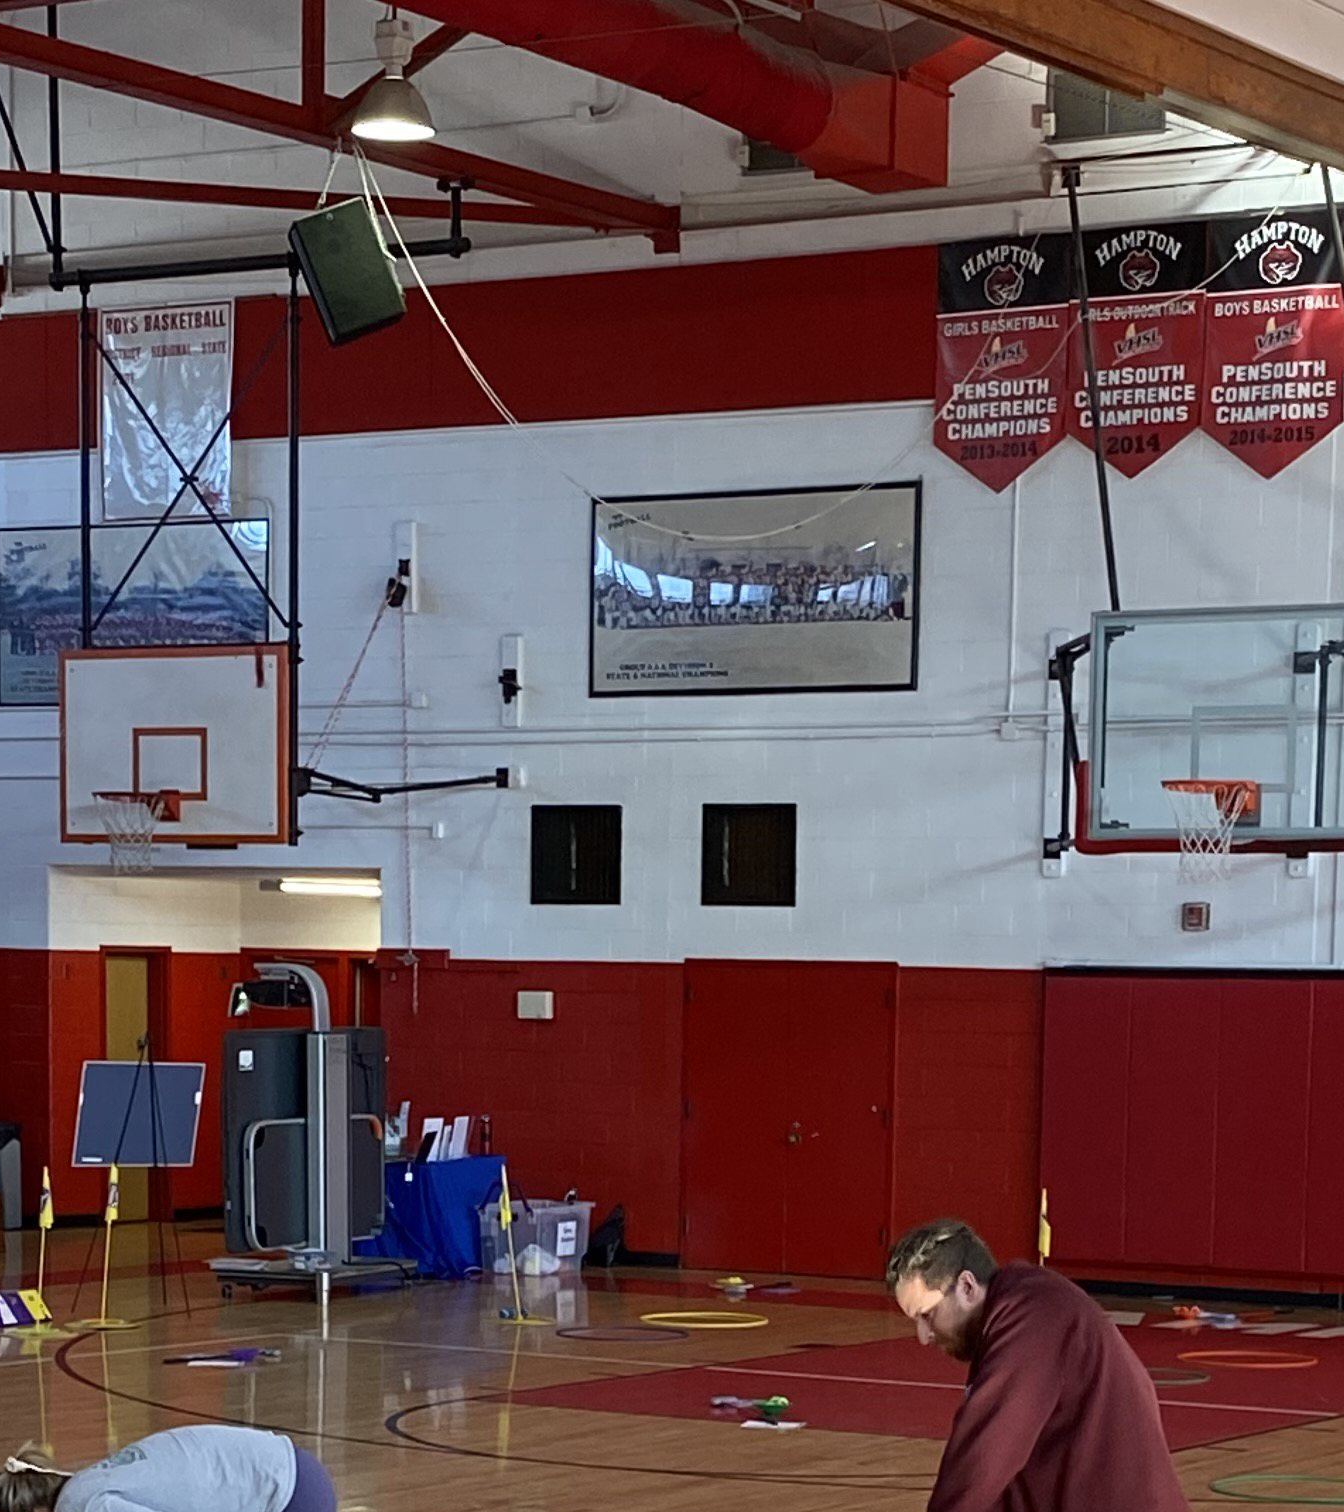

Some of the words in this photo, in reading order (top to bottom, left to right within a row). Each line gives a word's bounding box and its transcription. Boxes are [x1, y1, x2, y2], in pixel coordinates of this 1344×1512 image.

[1095, 229, 1182, 267] HAMPTON
[1234, 221, 1325, 260] HAMPTON
[961, 245, 1045, 282] HAMPTON
[1214, 301, 1250, 317] BOYS
[1253, 294, 1340, 314] BASKETBALL
[105, 316, 139, 335] BOYS
[144, 309, 227, 333] BASKETBALL
[944, 321, 979, 337] GIRLS
[981, 315, 1060, 334] BASKETBALL
[1222, 360, 1326, 383] PENSOUTH
[953, 378, 1049, 401] PENSOUTH
[1074, 384, 1196, 408] CNFERENCE
[1210, 380, 1337, 404] CONFERENCE
[942, 397, 1058, 421] CONFERENCE
[1216, 402, 1330, 425] CHAMPIONS
[947, 417, 1052, 440] CHAMPIONS
[1229, 425, 1315, 446] 2014-2015
[960, 440, 1038, 461] 2013-2014
[1106, 433, 1161, 455] 2014
